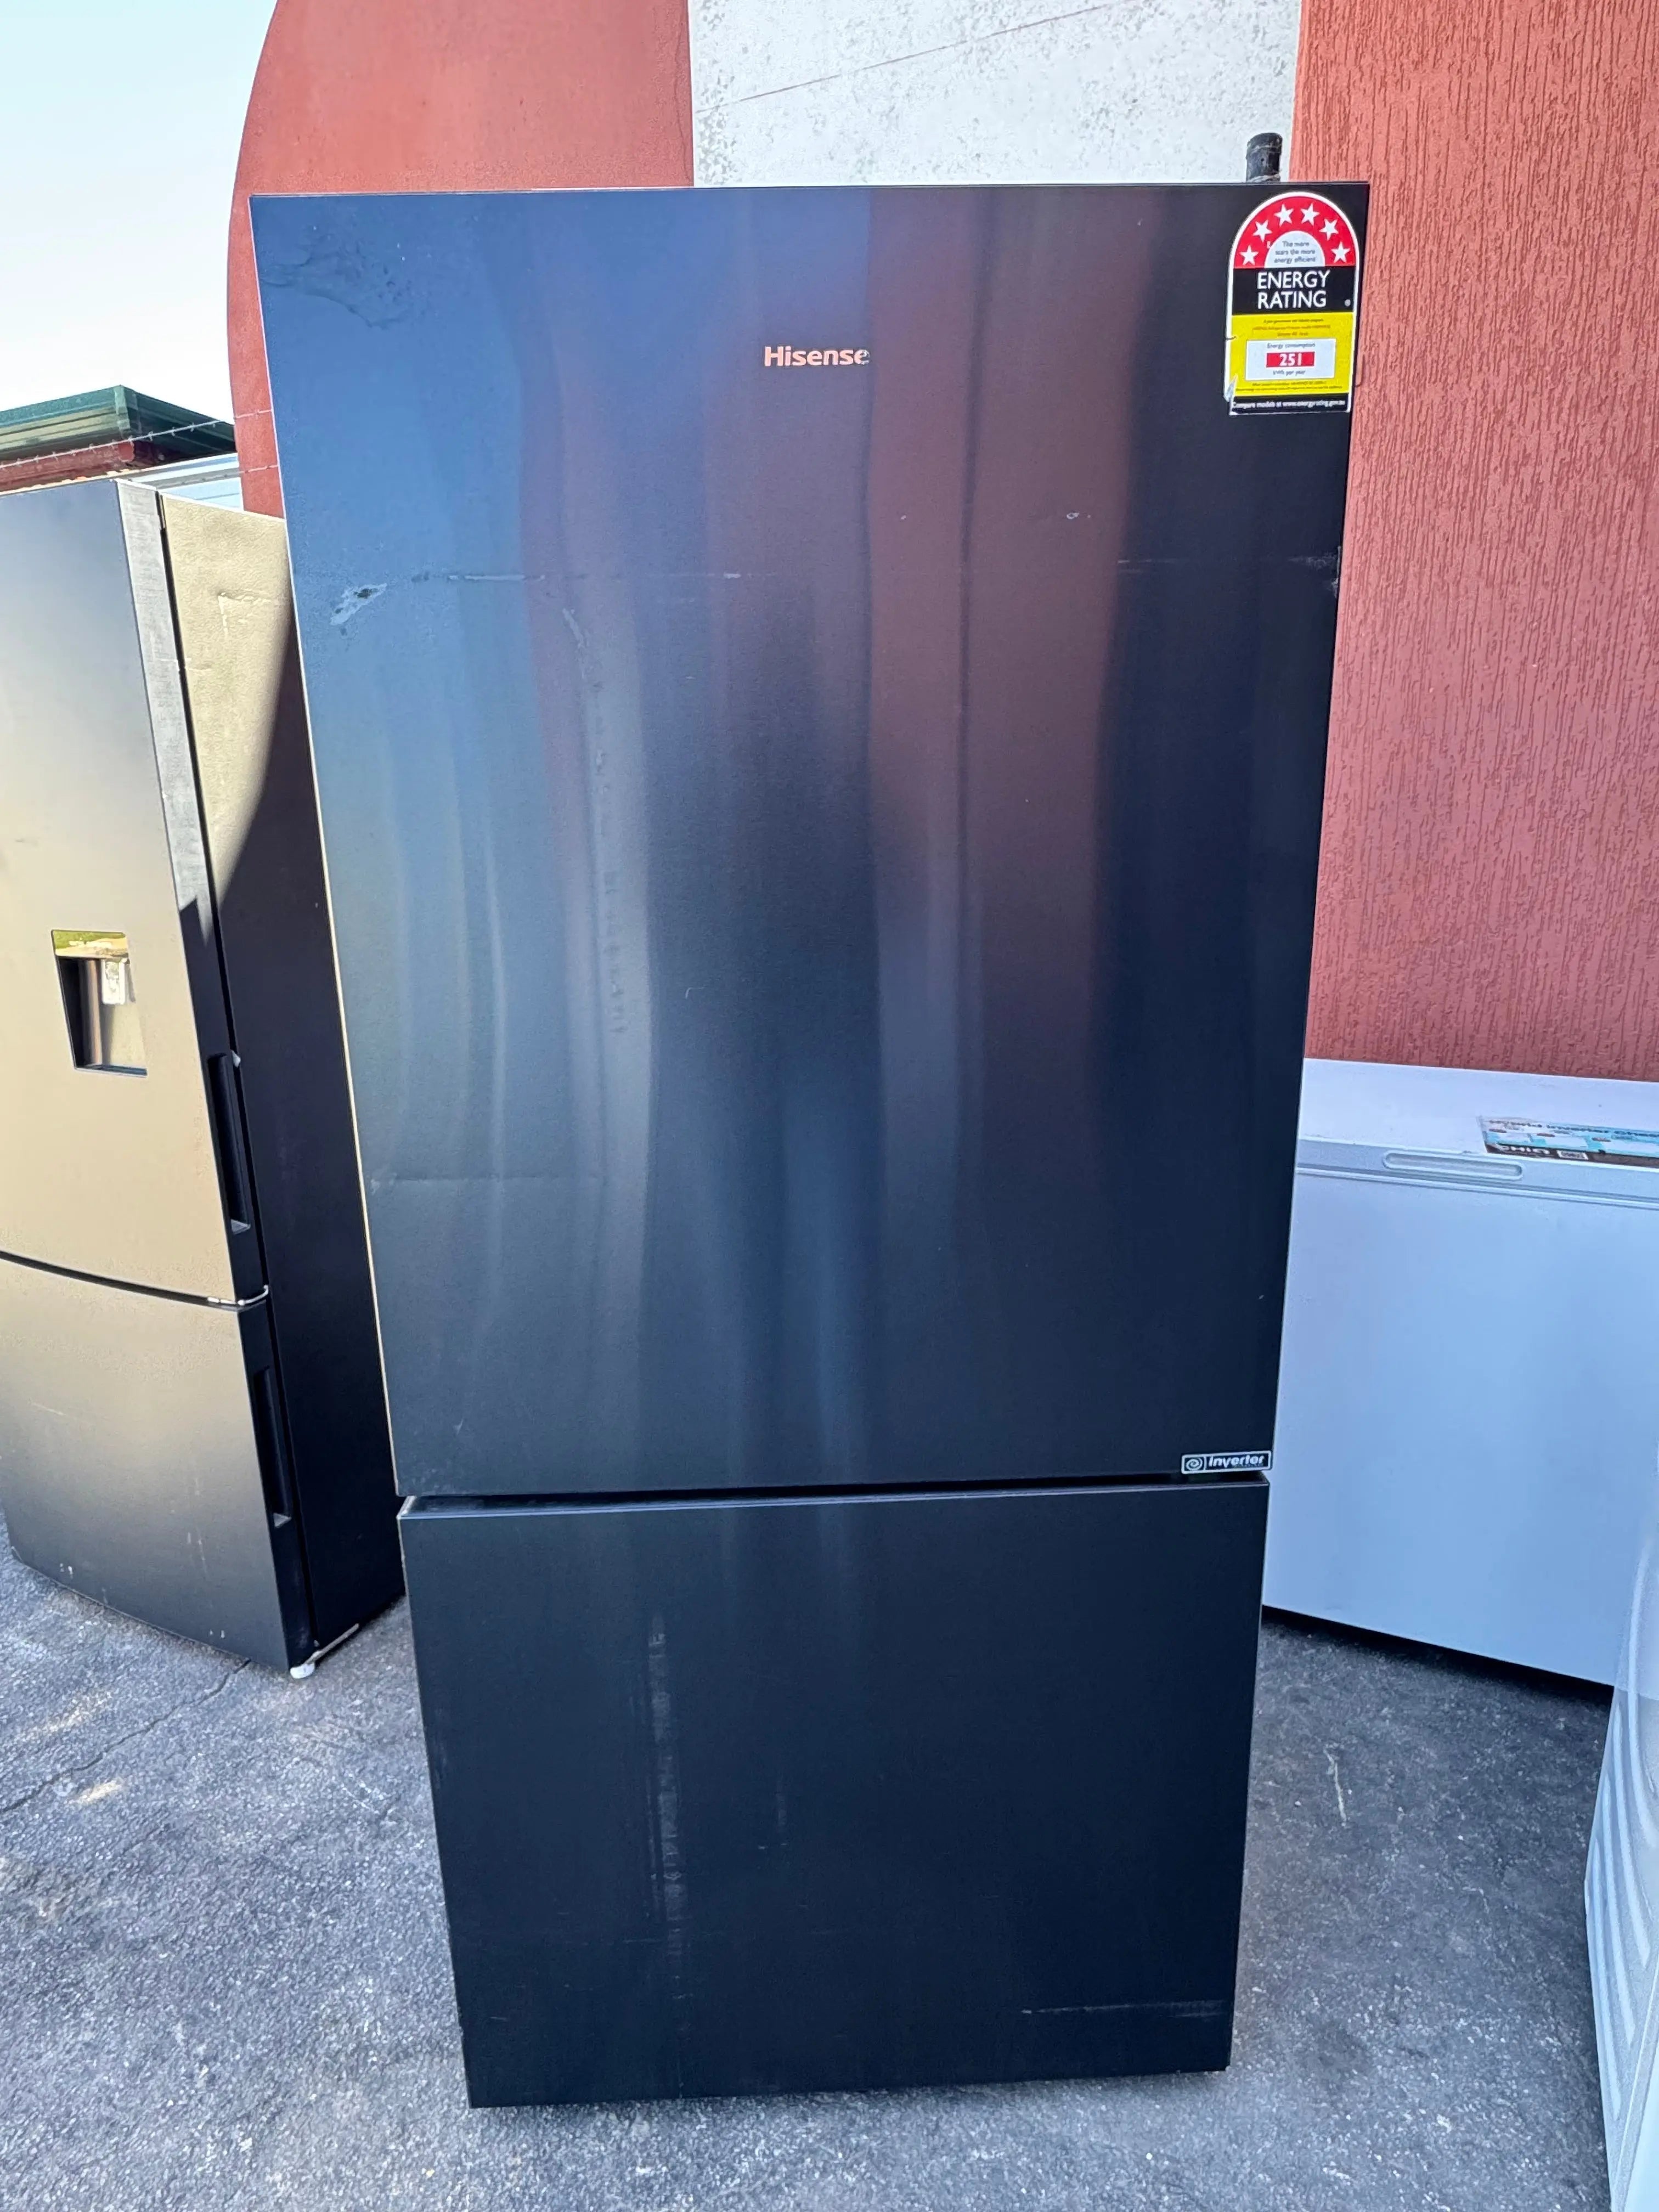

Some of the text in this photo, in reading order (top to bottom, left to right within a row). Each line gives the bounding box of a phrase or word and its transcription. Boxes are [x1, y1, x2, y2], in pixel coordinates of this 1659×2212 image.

[1257, 270, 1330, 289] ENERGY
[1258, 290, 1327, 309] RATING
[764, 346, 870, 366] Hisense
[1279, 353, 1302, 366] 251
[1209, 1455, 1265, 1468] Inverter
